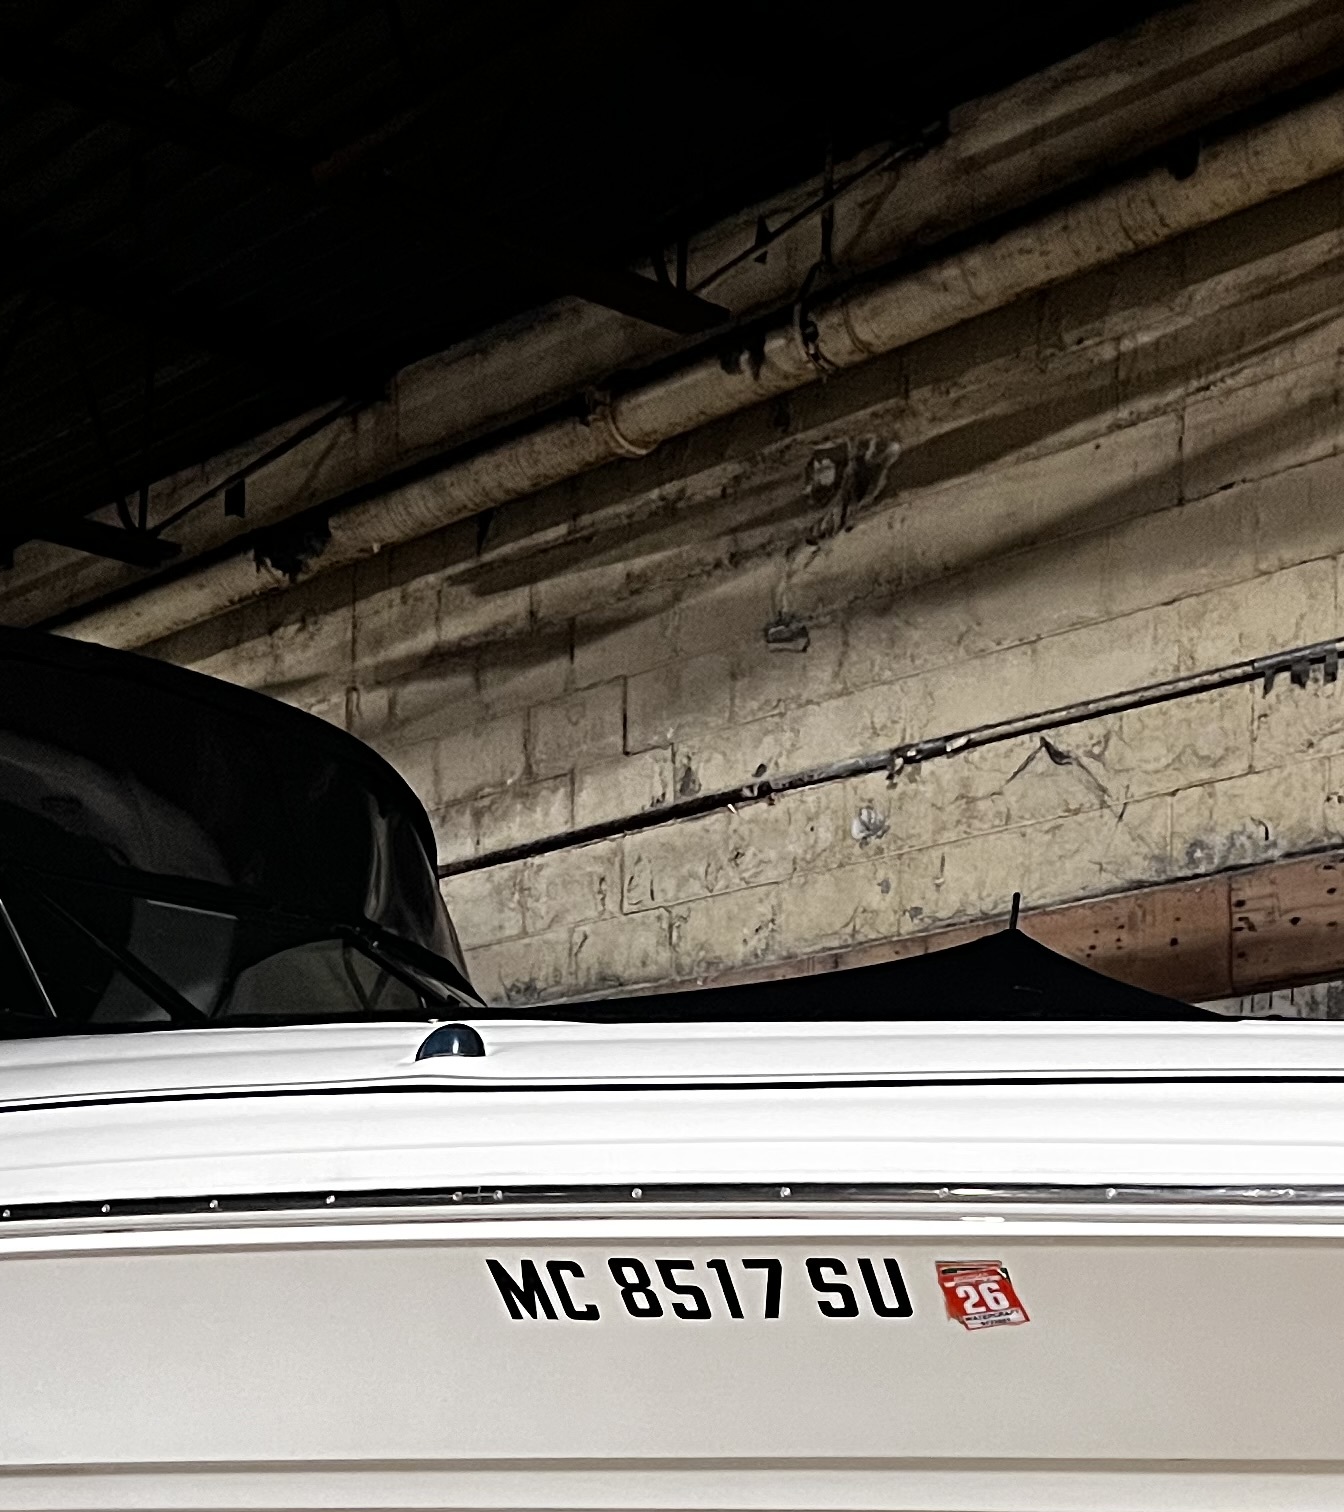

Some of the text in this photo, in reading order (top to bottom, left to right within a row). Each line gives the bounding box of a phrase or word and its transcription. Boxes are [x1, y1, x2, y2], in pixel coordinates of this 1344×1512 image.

[485, 1257, 914, 1321] MC 8517 SU
[955, 1282, 1009, 1314] 26
